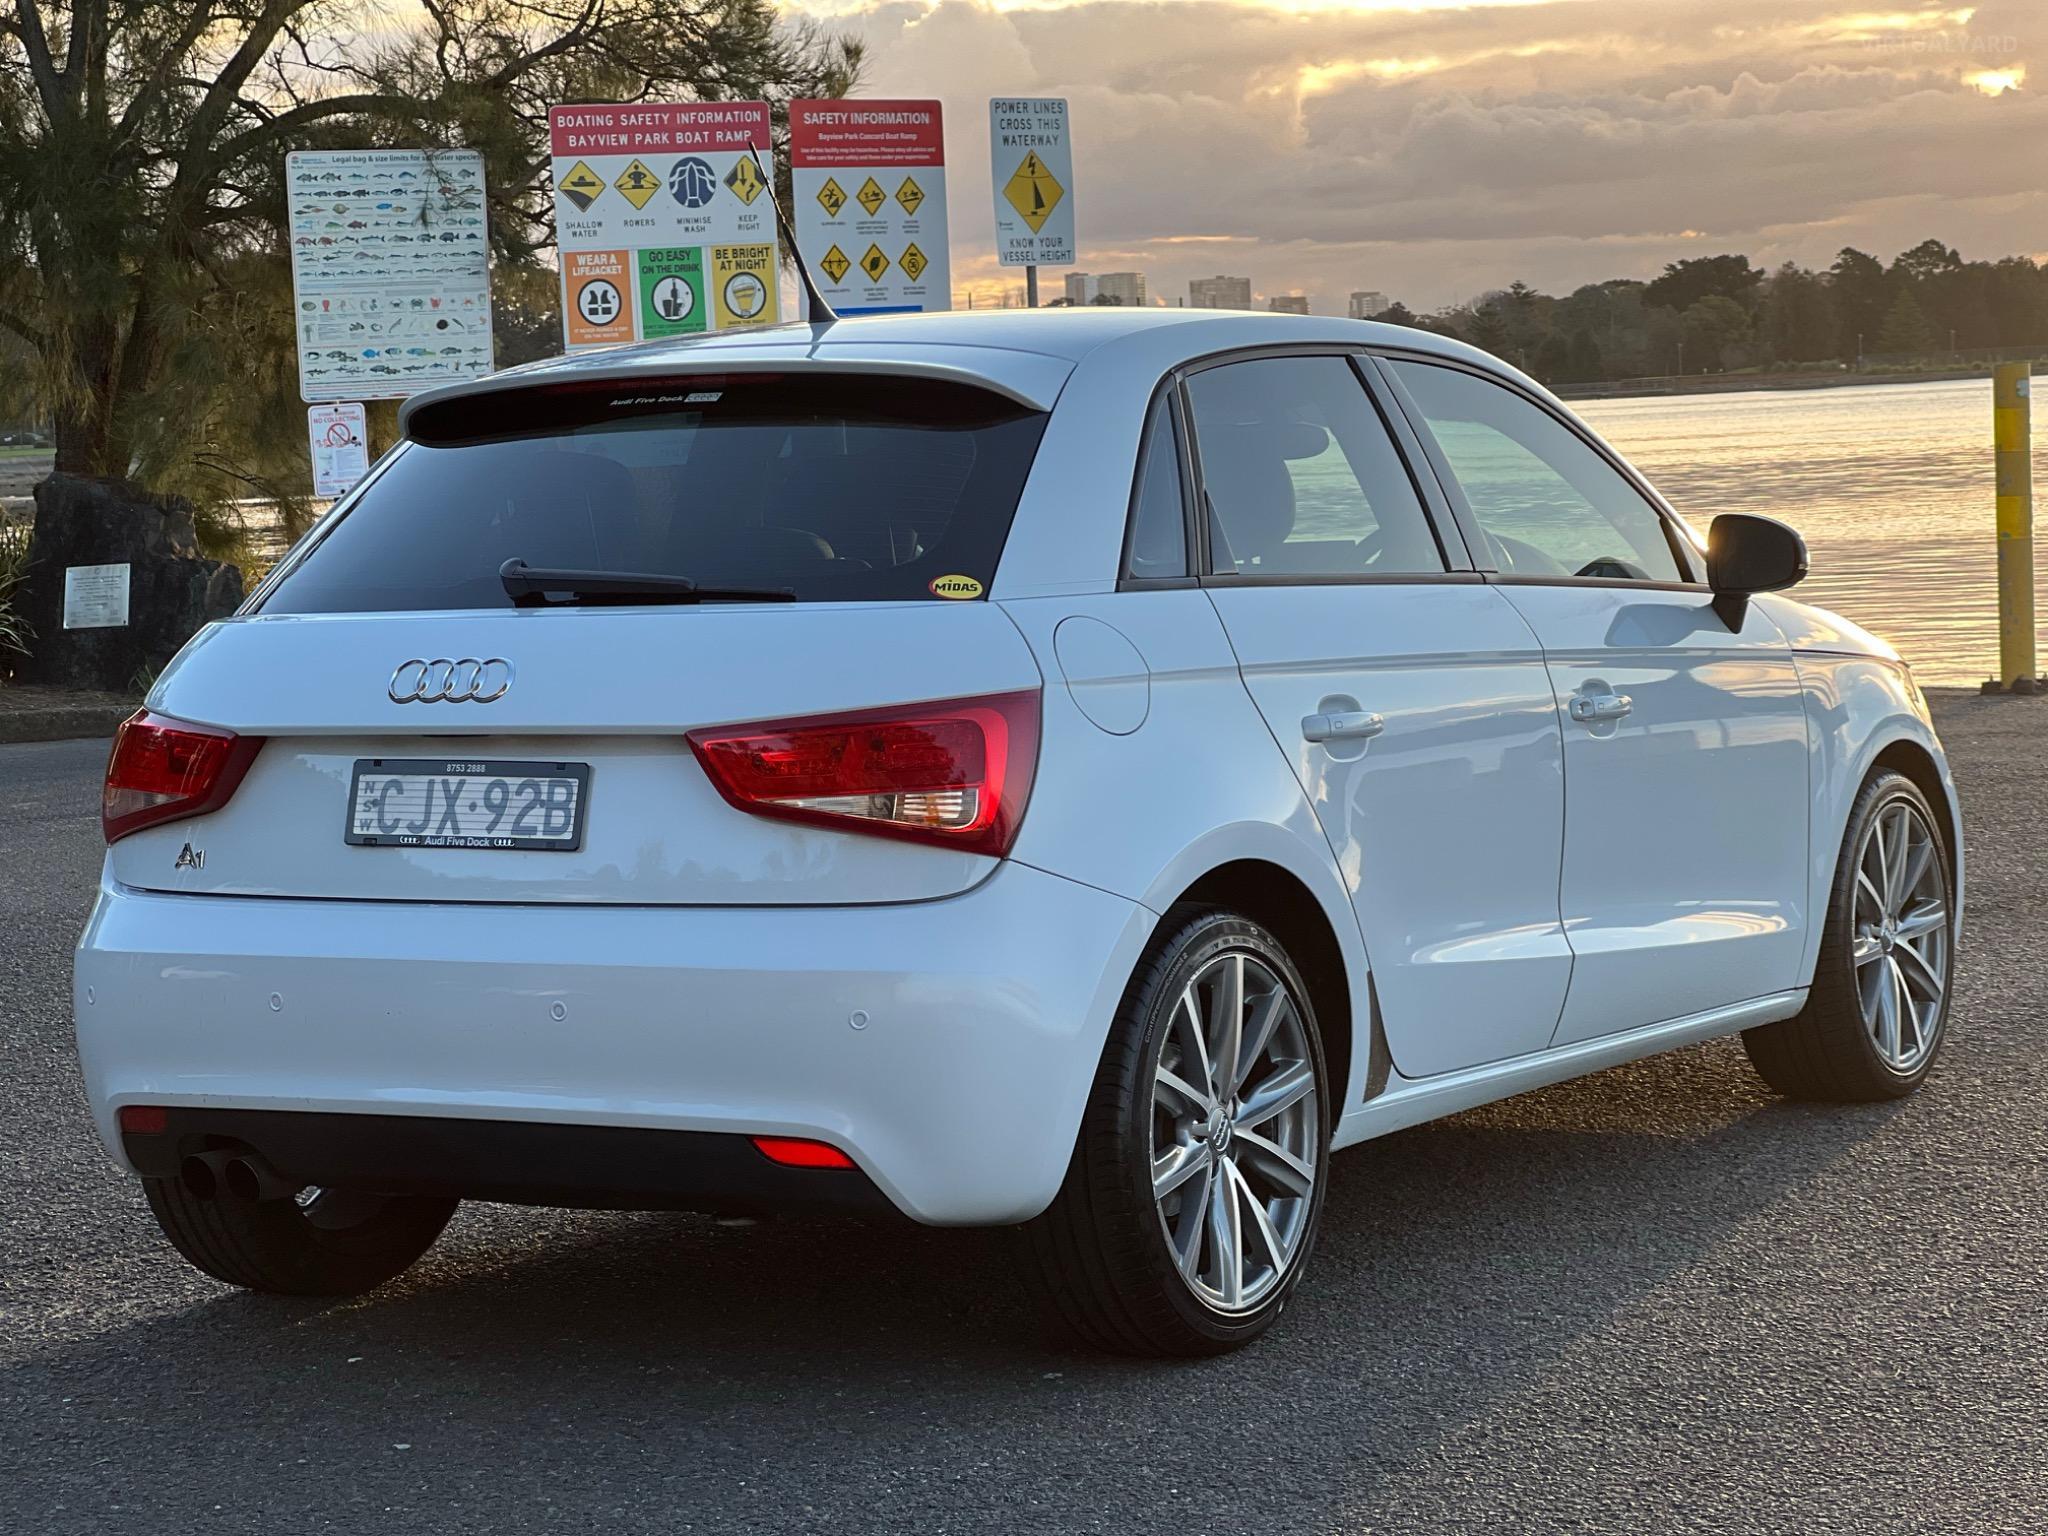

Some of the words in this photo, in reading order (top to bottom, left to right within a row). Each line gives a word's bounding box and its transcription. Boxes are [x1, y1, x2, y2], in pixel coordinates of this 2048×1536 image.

[994, 102, 1029, 114] POWER
[1033, 102, 1064, 114] LINES
[557, 114, 613, 128] BOATING
[620, 112, 670, 126] SAFETY
[676, 110, 762, 125] INFORMATION
[803, 112, 848, 124] SAFETY
[850, 112, 930, 124] INFORMATION
[999, 118, 1032, 130] CROSS
[1037, 118, 1061, 130] THIS
[568, 134, 629, 147] BAYVIEW
[635, 132, 670, 145] PARK
[676, 131, 709, 144] BOAT
[716, 130, 752, 142] RAMP
[818, 132, 844, 141] Bayview
[844, 132, 858, 140] Park
[859, 132, 884, 140] Concord
[885, 132, 900, 140] Boat
[900, 132, 918, 141] Ramp
[1001, 134, 1060, 146] WATERWAY
[332, 155, 351, 164] Legal
[353, 155, 366, 164] bag
[455, 153, 480, 162] species
[623, 219, 656, 228] ROWERS
[677, 216, 712, 225] MINIMISE
[739, 214, 758, 223] KEEP
[565, 221, 603, 230] SHALLOW
[684, 224, 706, 233] WASH
[738, 222, 760, 231] RIGHT
[571, 229, 598, 238] WATER
[1009, 238, 1034, 248] KNOW
[1039, 237, 1063, 248] YOUR
[576, 254, 604, 265] WEAR
[605, 253, 617, 264] A
[649, 252, 665, 262] GO
[666, 250, 692, 261] EASY
[715, 249, 730, 260] BE
[731, 247, 770, 259] BRIGHT
[1002, 251, 1036, 262] VESSEL
[1040, 250, 1072, 261] HEIGHT
[572, 265, 623, 276] LIFEJACKET
[641, 265, 655, 274] ON
[656, 265, 673, 274] THE
[674, 263, 700, 273] DRINK
[720, 260, 734, 271] AT
[735, 259, 767, 270] NIGHT
[609, 398, 634, 406] Audi
[323, 415, 360, 423] COLLECTING
[446, 764, 465, 772] 8753
[424, 835, 445, 846] Audi
[446, 836, 466, 846] Five
[467, 836, 490, 847] Dock
[175, 842, 206, 870] A1
